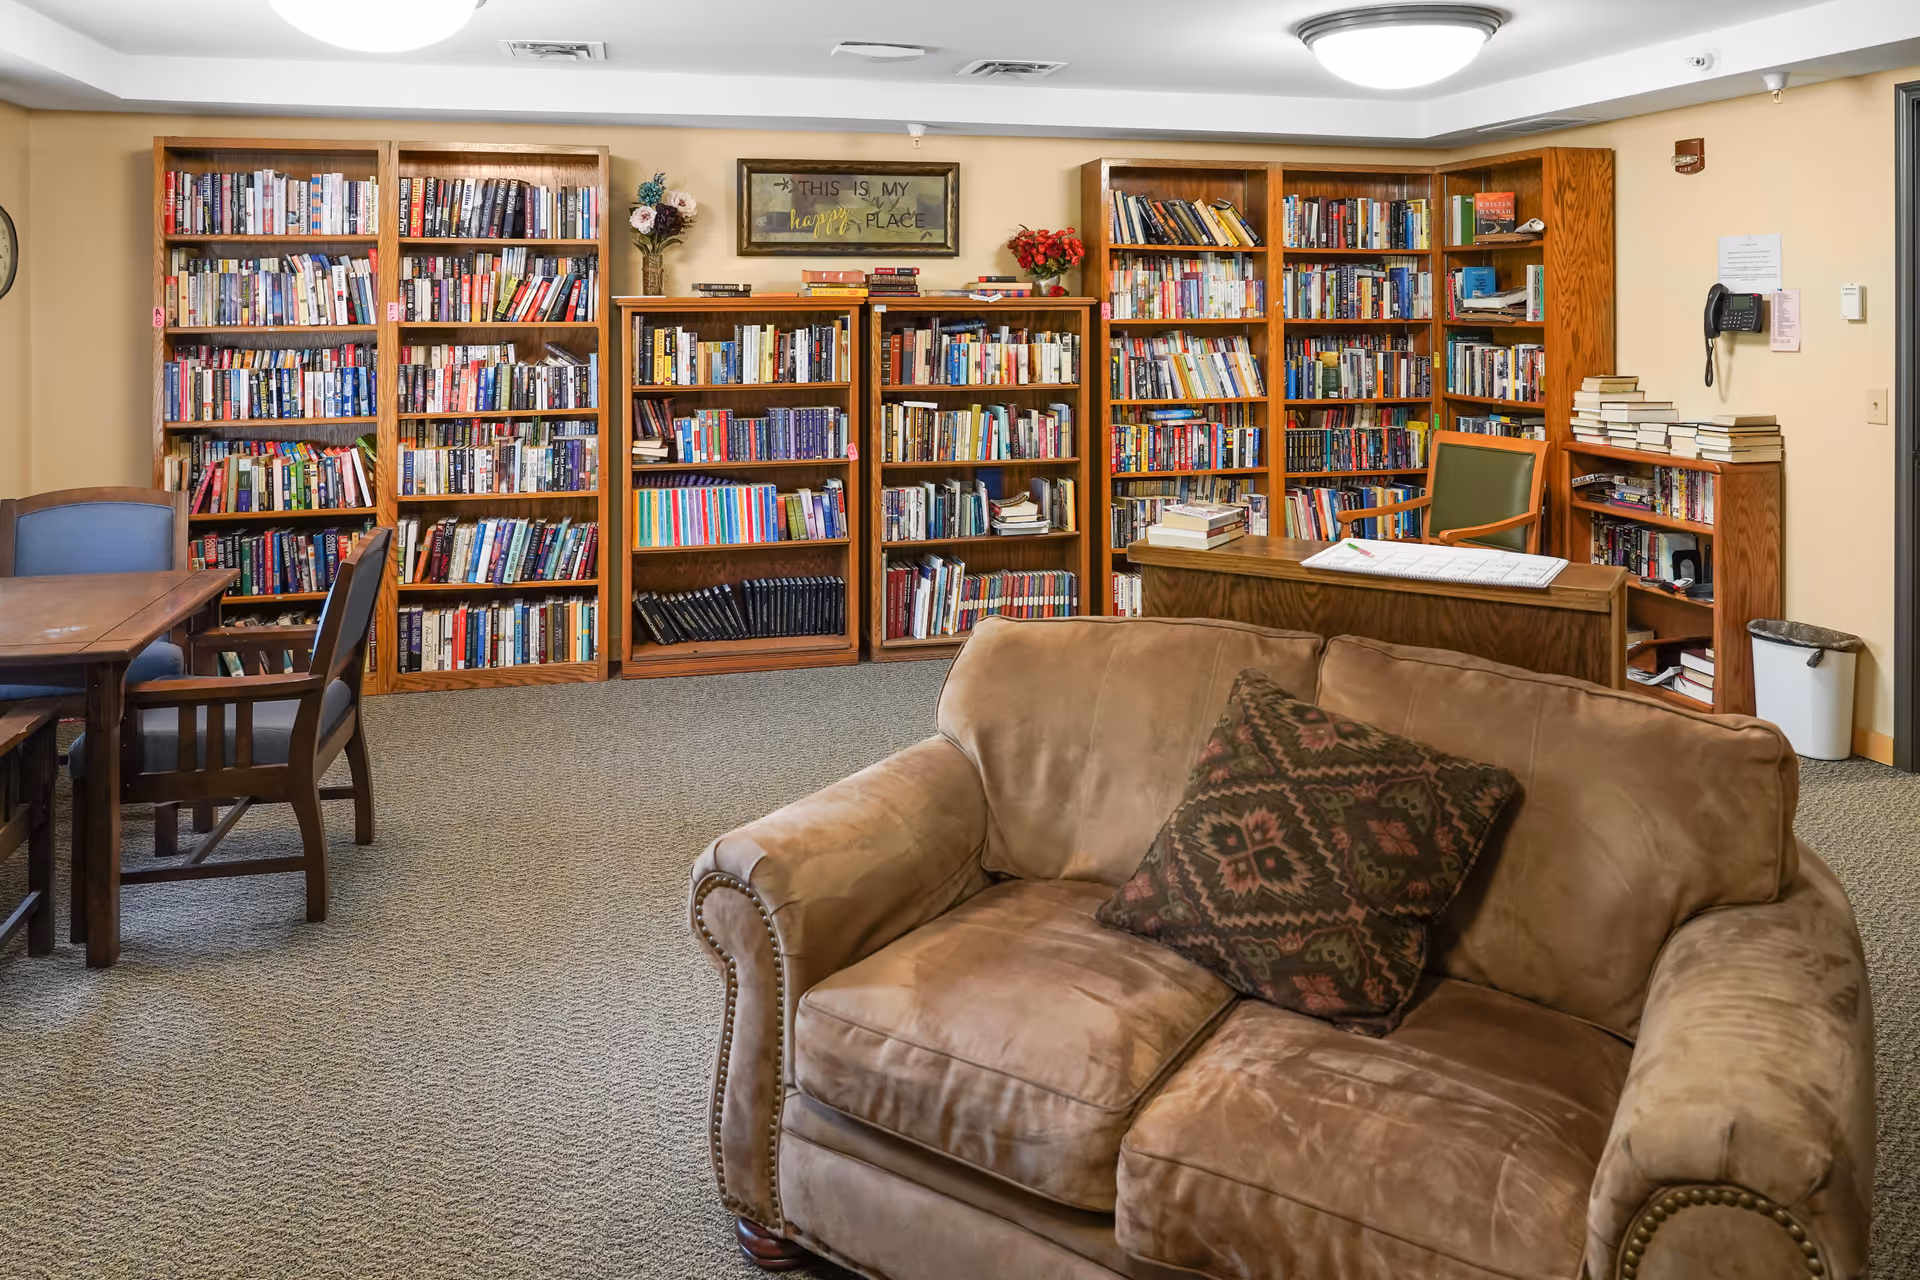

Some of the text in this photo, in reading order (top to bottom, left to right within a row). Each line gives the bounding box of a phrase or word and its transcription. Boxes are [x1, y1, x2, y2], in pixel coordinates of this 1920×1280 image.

[799, 180, 909, 197] THIS IS MY
[790, 206, 925, 238] happy PLACE
[155, 308, 162, 317] A
[155, 317, 162, 326] B
